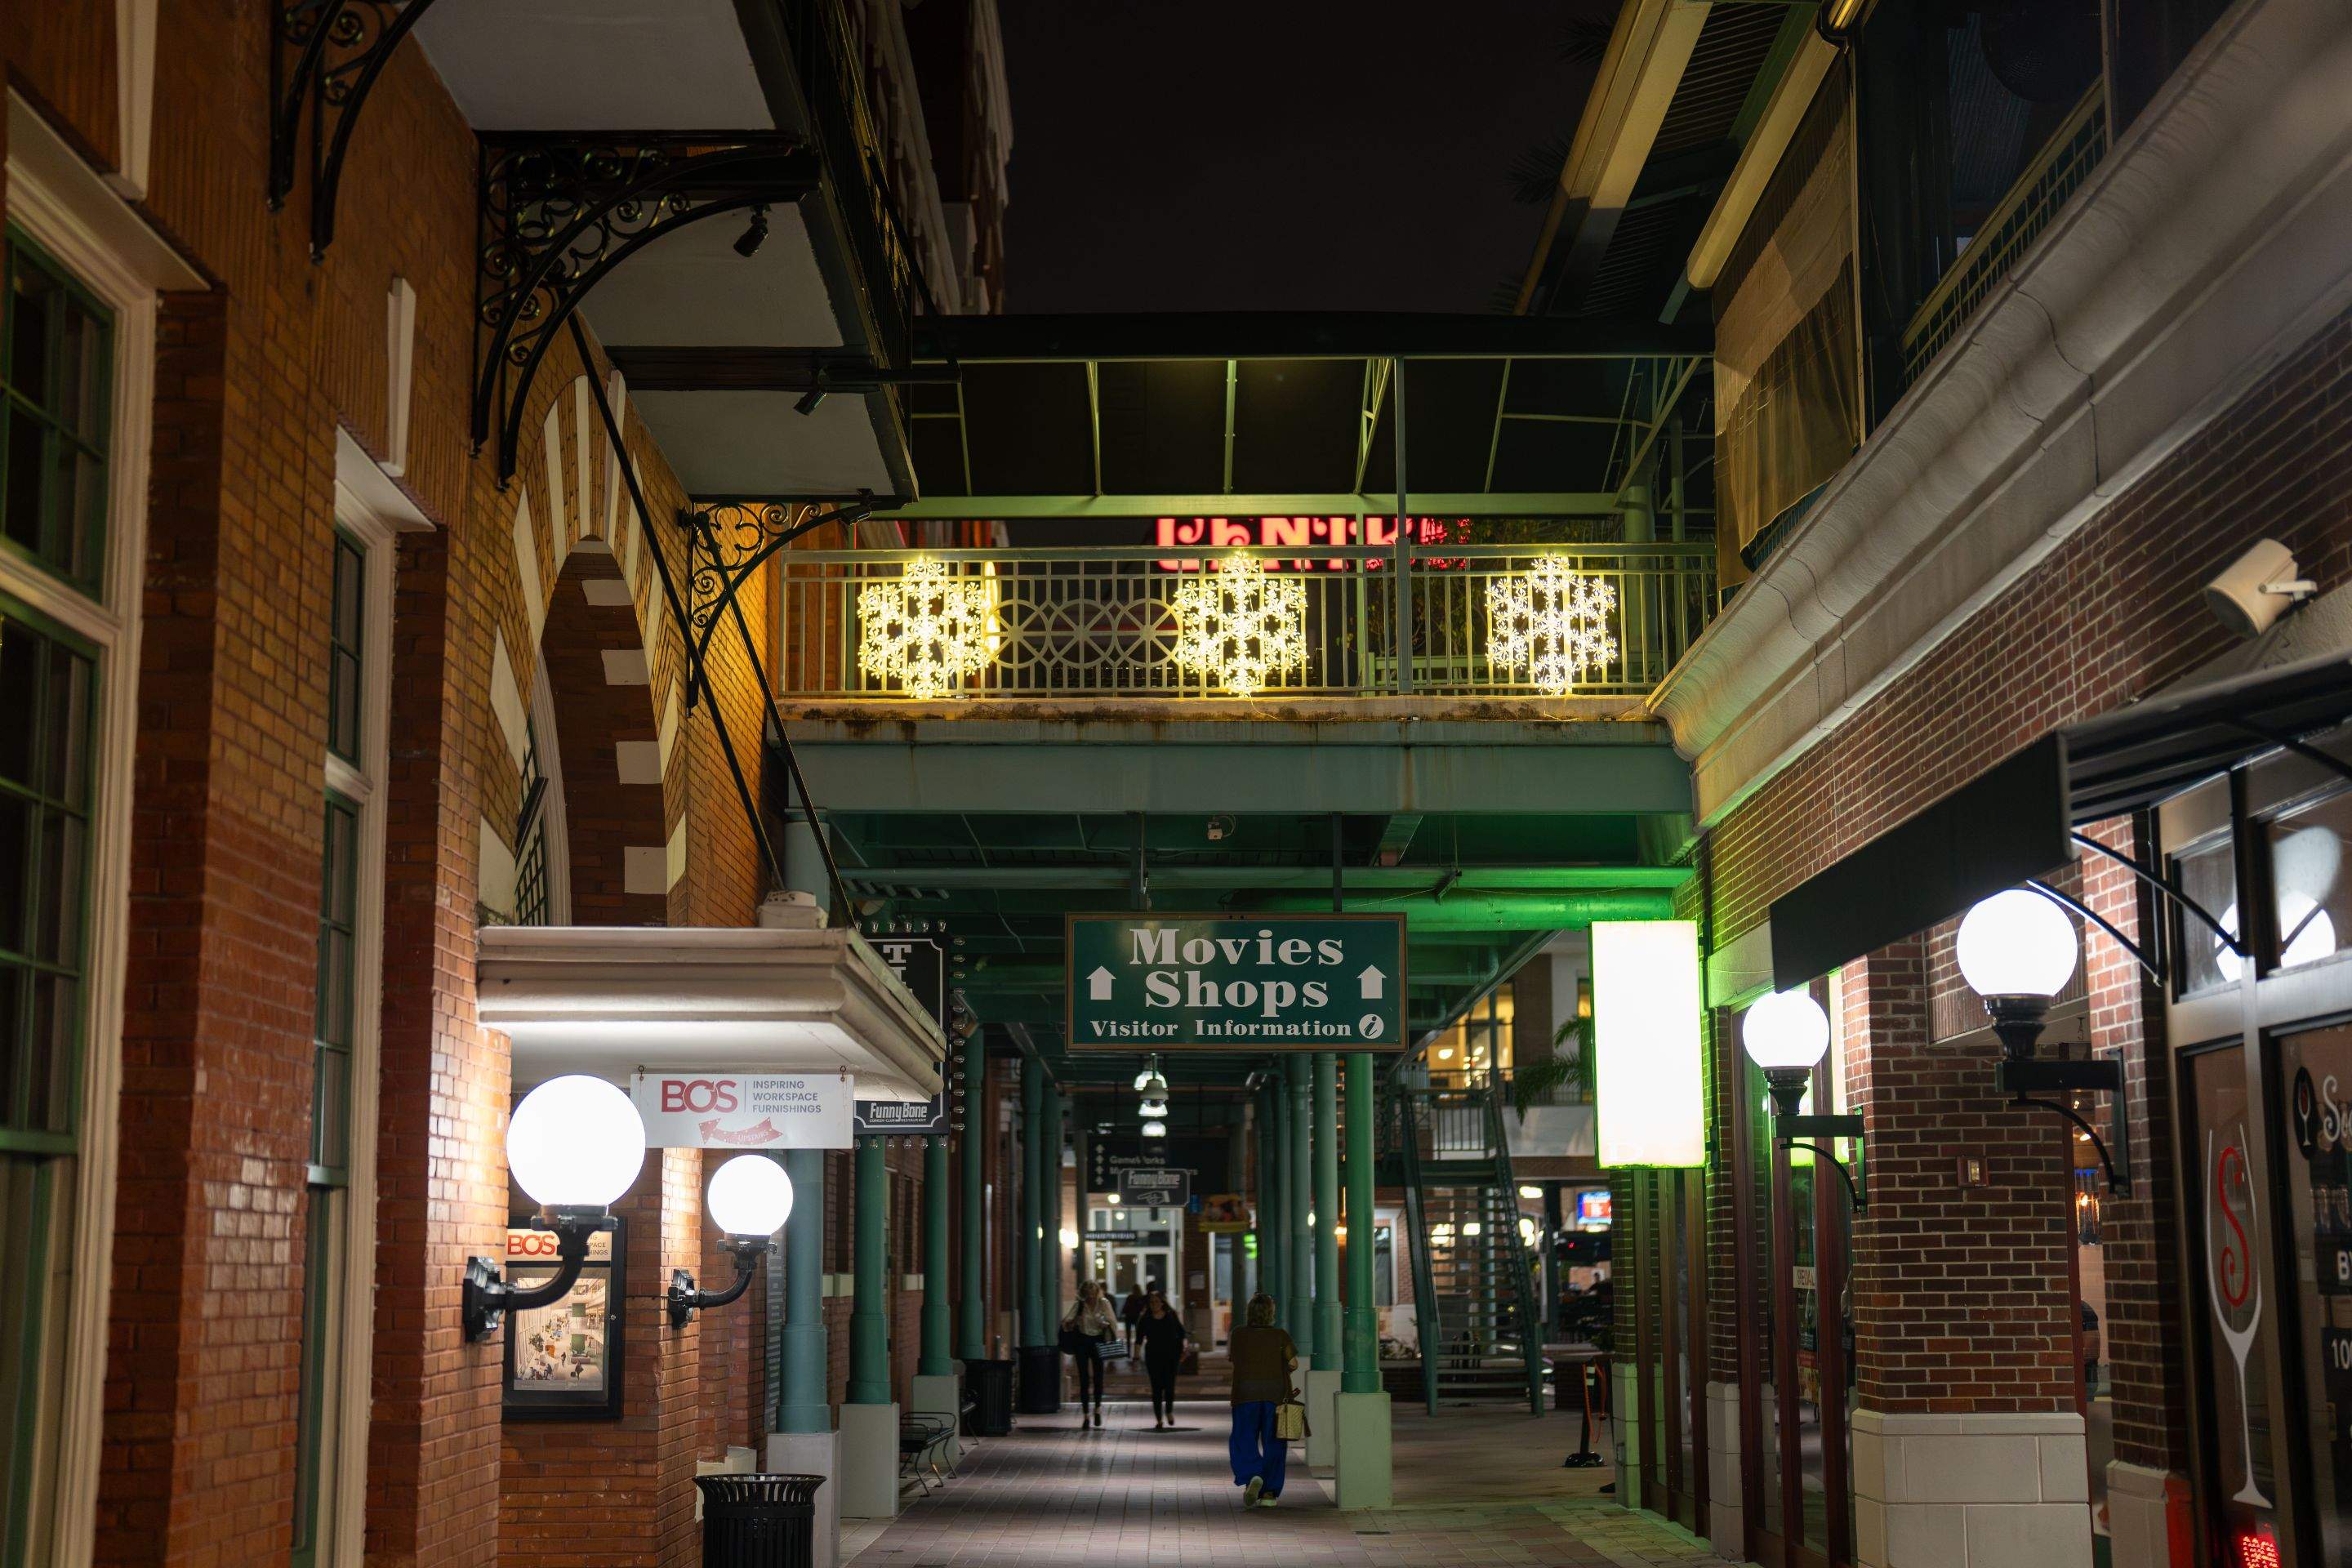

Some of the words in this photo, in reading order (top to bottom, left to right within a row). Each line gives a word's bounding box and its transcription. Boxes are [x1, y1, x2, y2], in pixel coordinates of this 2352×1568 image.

[1129, 928, 1344, 966] Movies
[1145, 970, 1329, 1018] Shops
[1089, 1019, 1178, 1036] Visitor
[1195, 1018, 1352, 1036] Information
[752, 1080, 804, 1090] INSPIRING
[661, 1079, 738, 1114] BOS
[752, 1092, 818, 1102] WORKSPACE
[751, 1104, 822, 1114] FURNISHINGS
[507, 1234, 556, 1256] BOS
